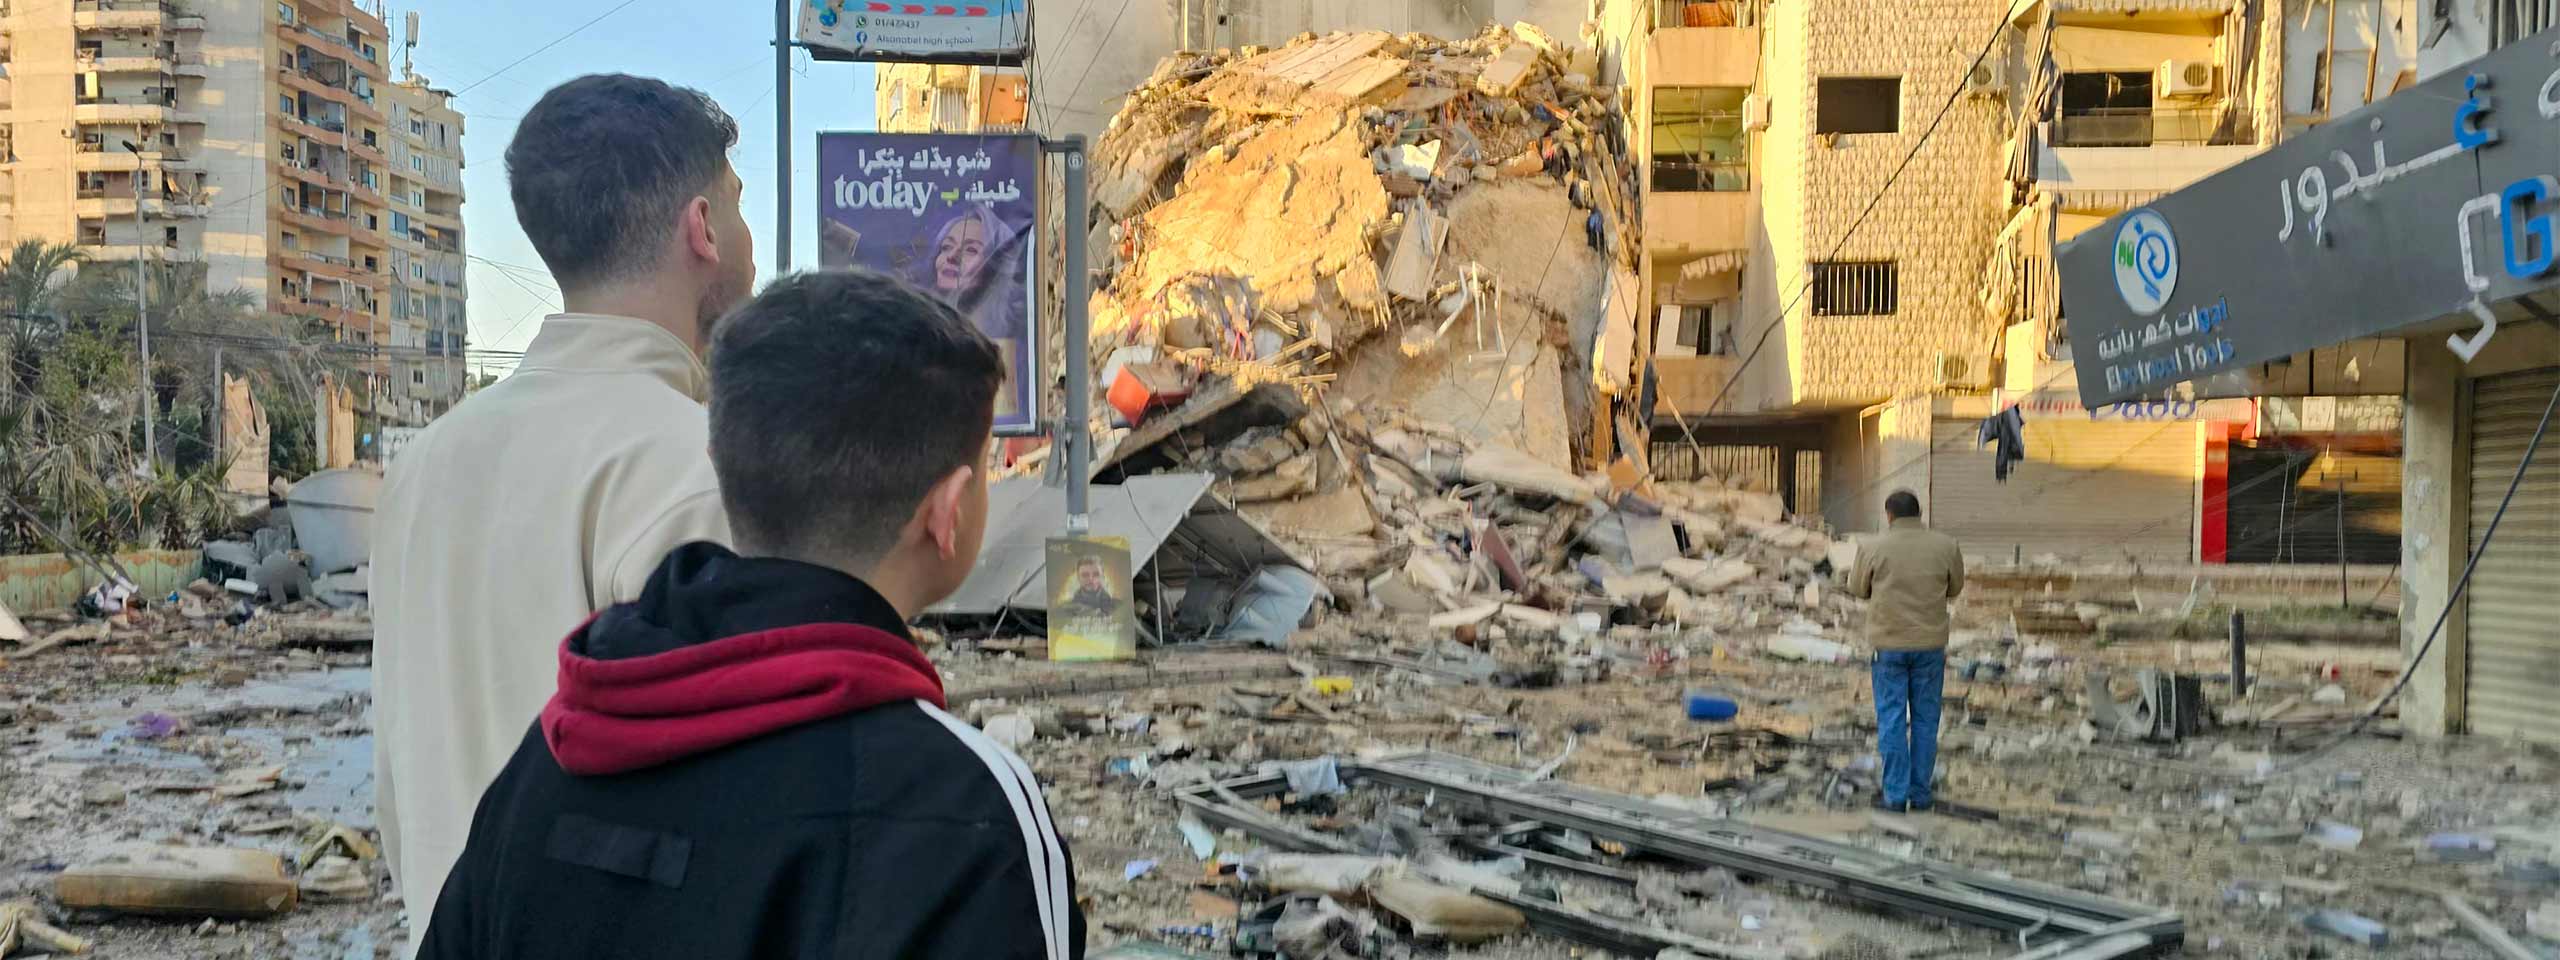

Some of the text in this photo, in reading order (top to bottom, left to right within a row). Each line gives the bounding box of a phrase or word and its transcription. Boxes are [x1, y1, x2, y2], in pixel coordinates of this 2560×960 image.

[923, 36, 943, 46] high
[945, 35, 973, 48] school
[957, 148, 991, 177] شو
[834, 174, 1020, 217] خليك ب today
[2183, 337, 2234, 373] Tools
